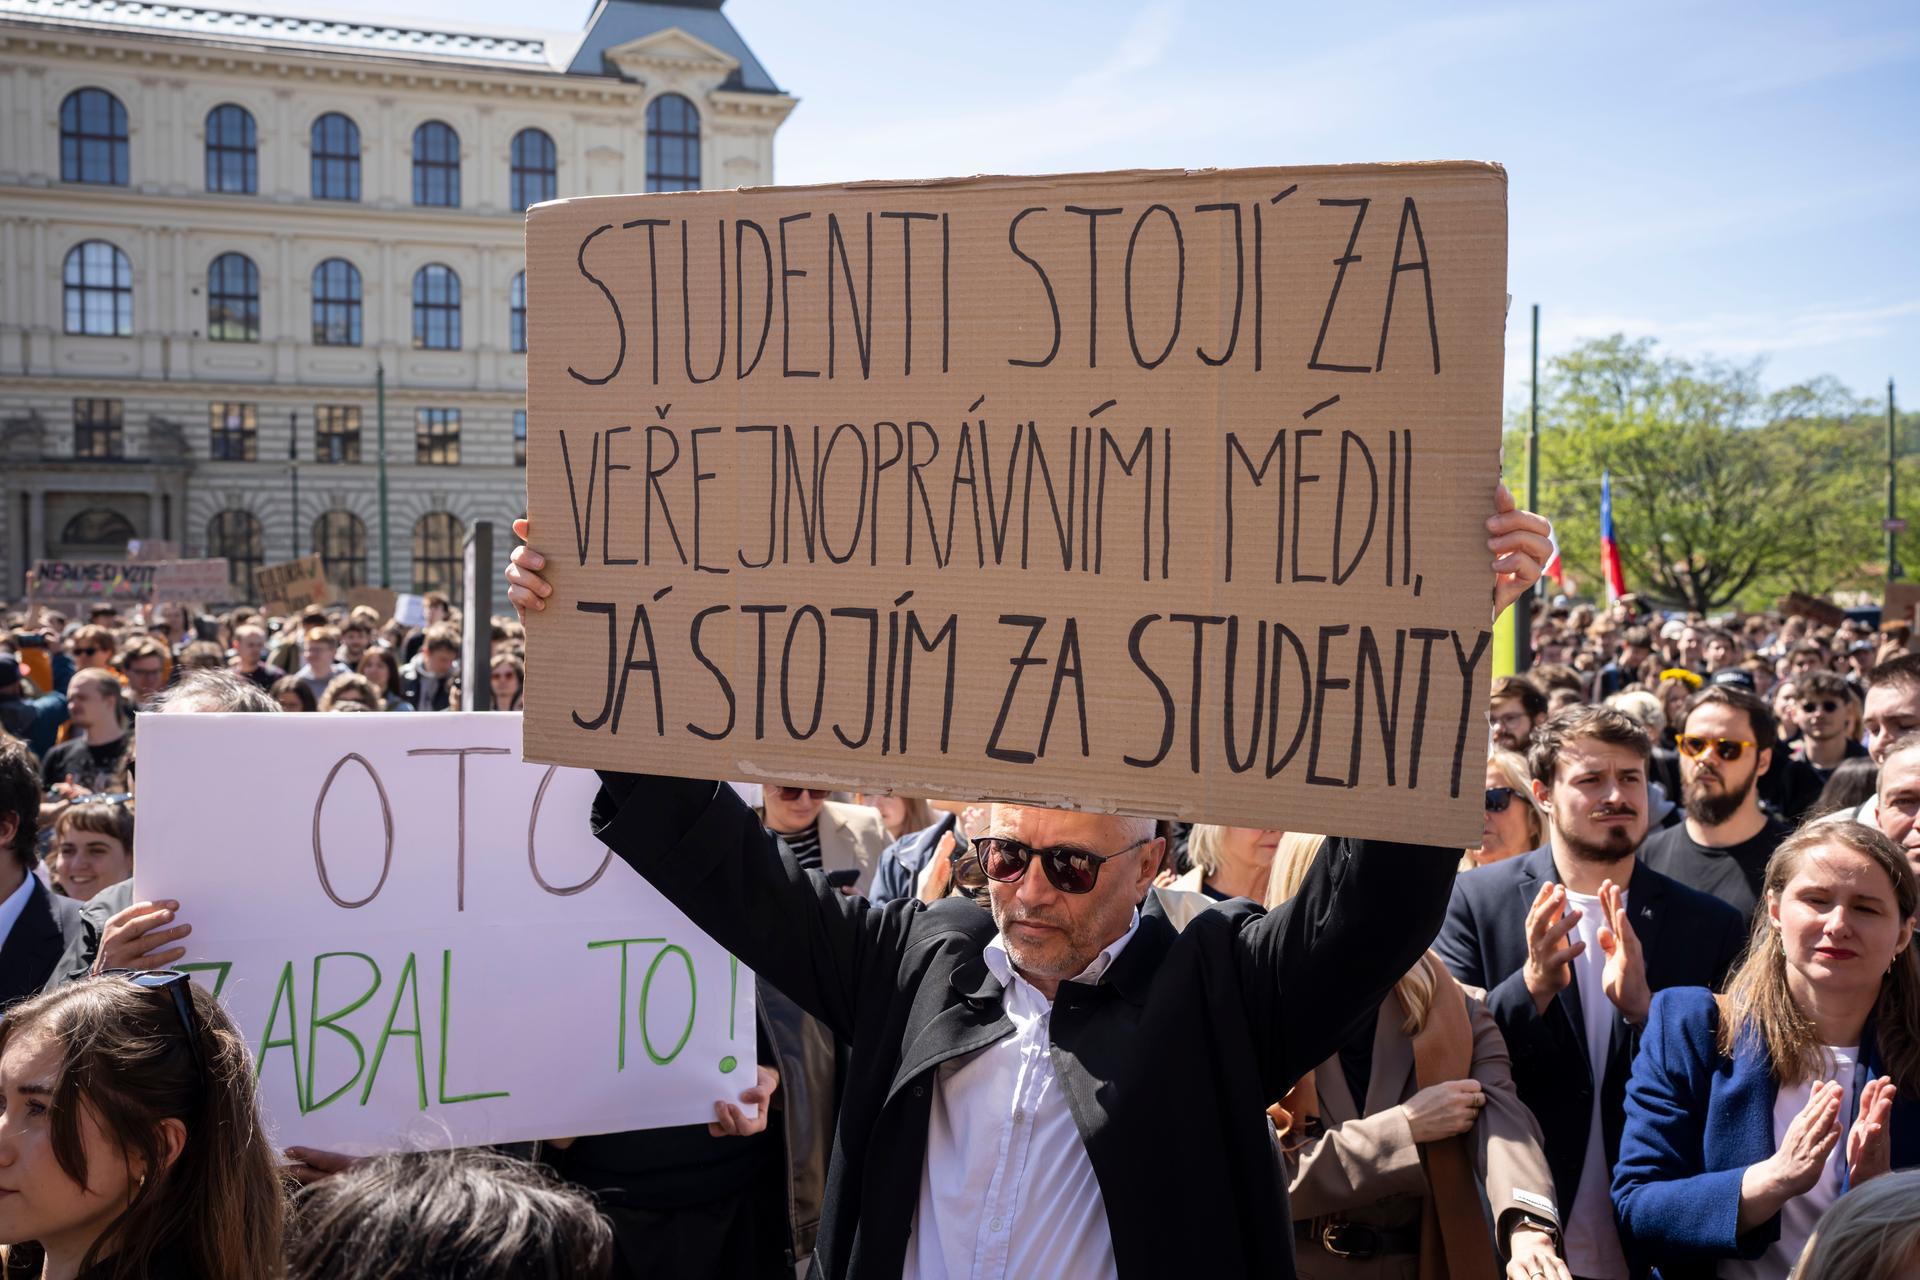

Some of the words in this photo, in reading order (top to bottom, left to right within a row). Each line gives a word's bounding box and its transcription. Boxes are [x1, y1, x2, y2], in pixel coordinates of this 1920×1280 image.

[567, 211, 951, 386] STUDENTI
[1007, 183, 1298, 372] STOJÍ
[1307, 197, 1441, 376] ZA
[559, 394, 1171, 582] VEŘEJNOPRÁVNÍMI
[1224, 394, 1424, 597] MÉDII,
[571, 585, 673, 737] JÁ
[685, 590, 958, 757] STOJÍM
[984, 614, 1090, 765] ZA
[1122, 613, 1493, 799] STUDENTY
